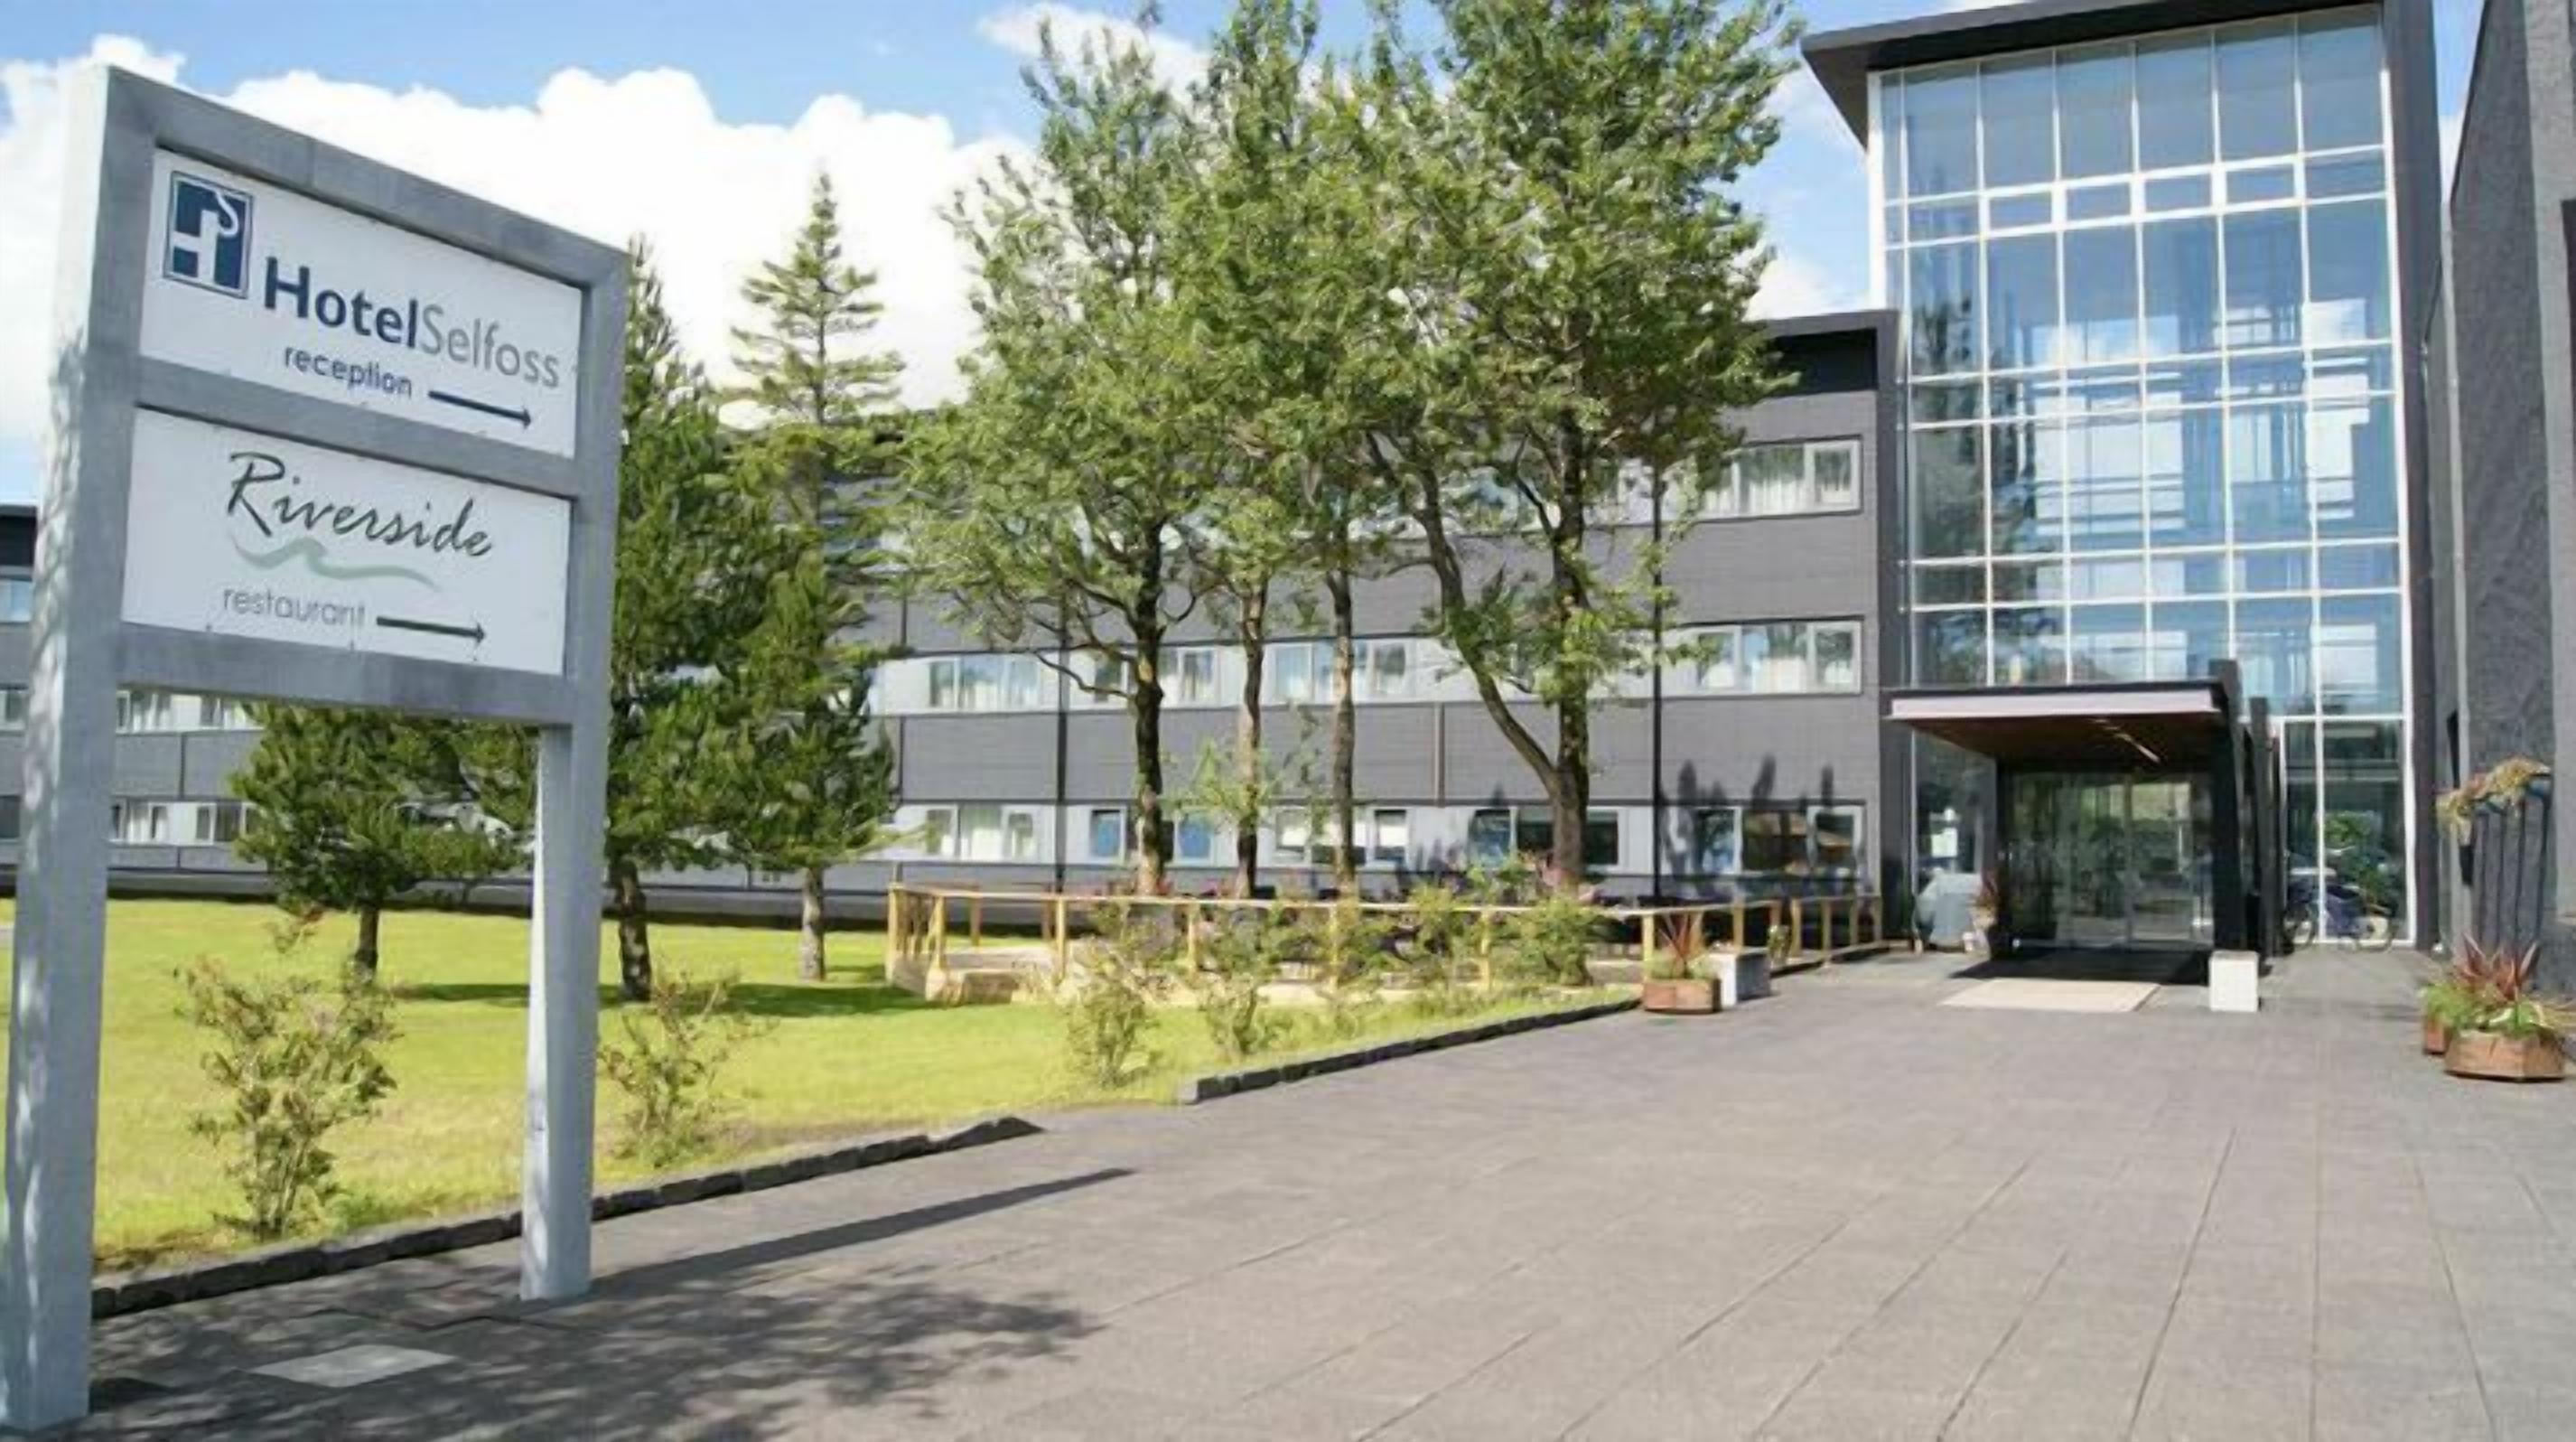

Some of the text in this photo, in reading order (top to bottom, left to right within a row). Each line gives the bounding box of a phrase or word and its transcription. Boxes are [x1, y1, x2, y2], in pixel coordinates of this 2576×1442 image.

[284, 344, 413, 398] reception
[226, 452, 494, 557] Riverside
[222, 586, 365, 628] restaurant
